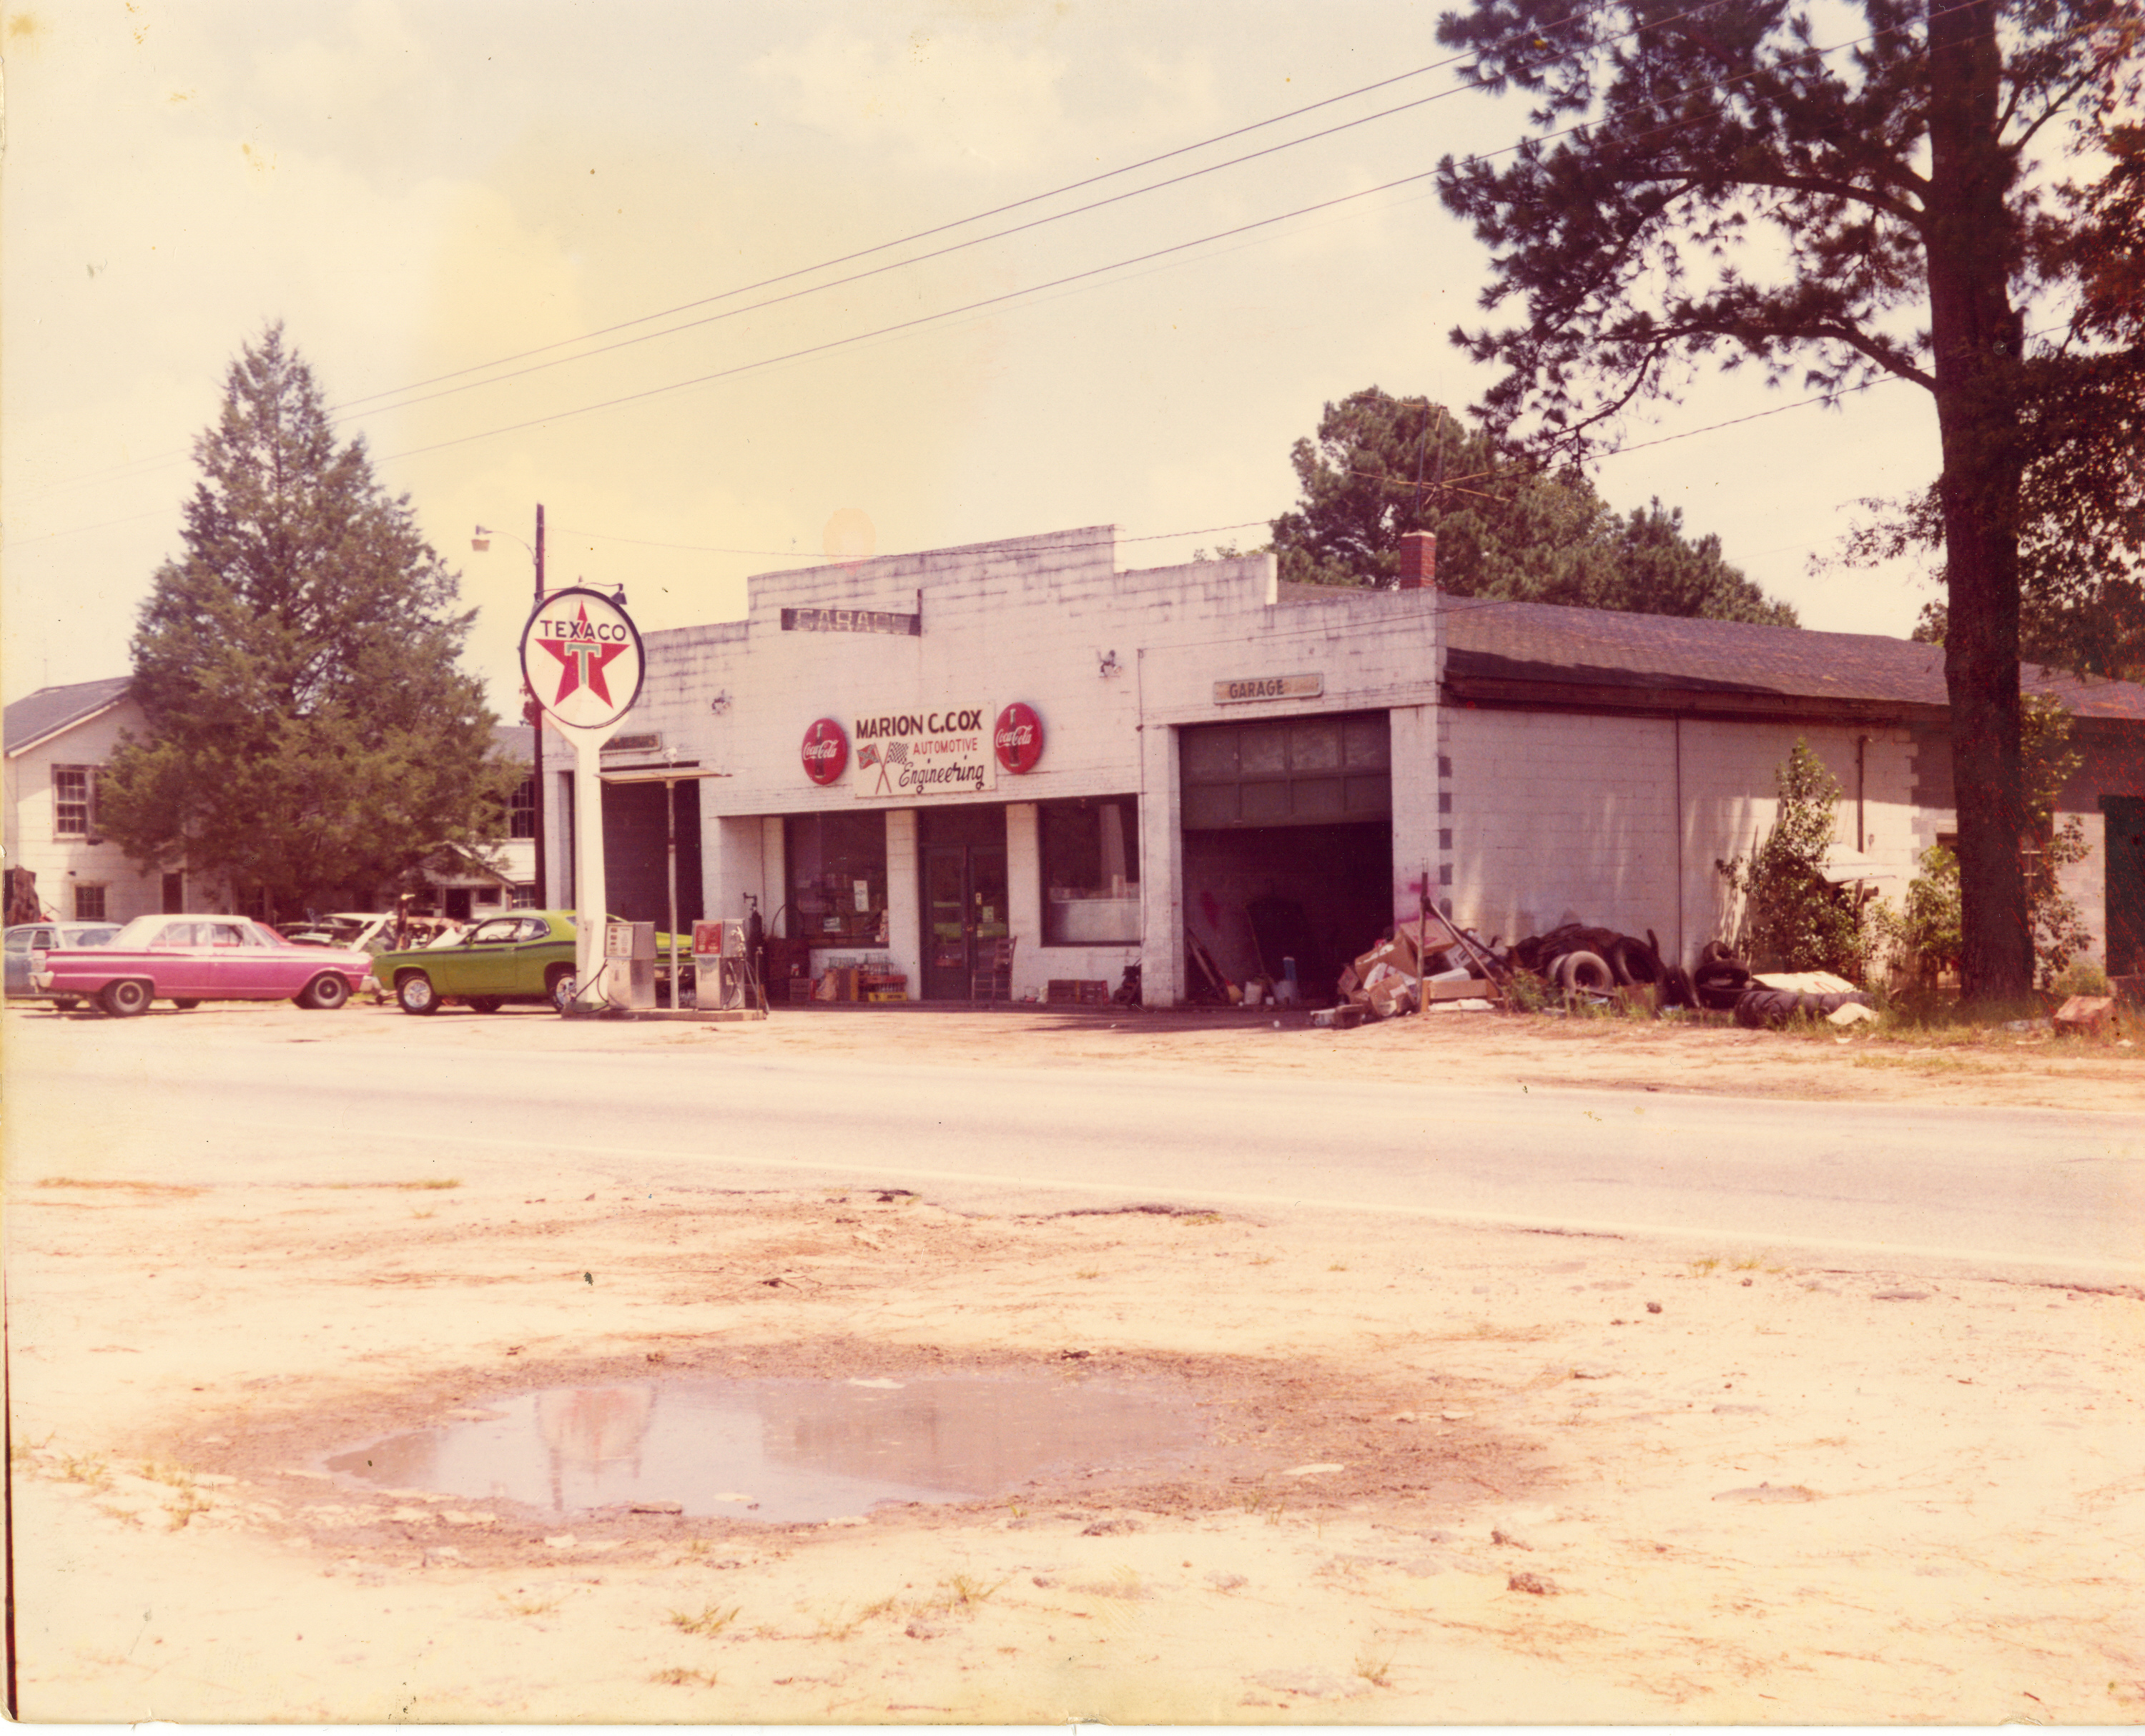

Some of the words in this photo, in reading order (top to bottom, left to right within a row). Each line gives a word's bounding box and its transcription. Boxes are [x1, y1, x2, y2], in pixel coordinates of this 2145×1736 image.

[540, 620, 626, 641] TEXACO
[564, 642, 601, 686] T
[1228, 680, 1284, 699] GARAGE
[856, 714, 923, 739] MARION
[995, 724, 1034, 748] Coca-Cola
[802, 739, 839, 760] Coca-Cola
[912, 737, 977, 755] AUTOMOTIVE
[899, 754, 985, 794] Engineering
